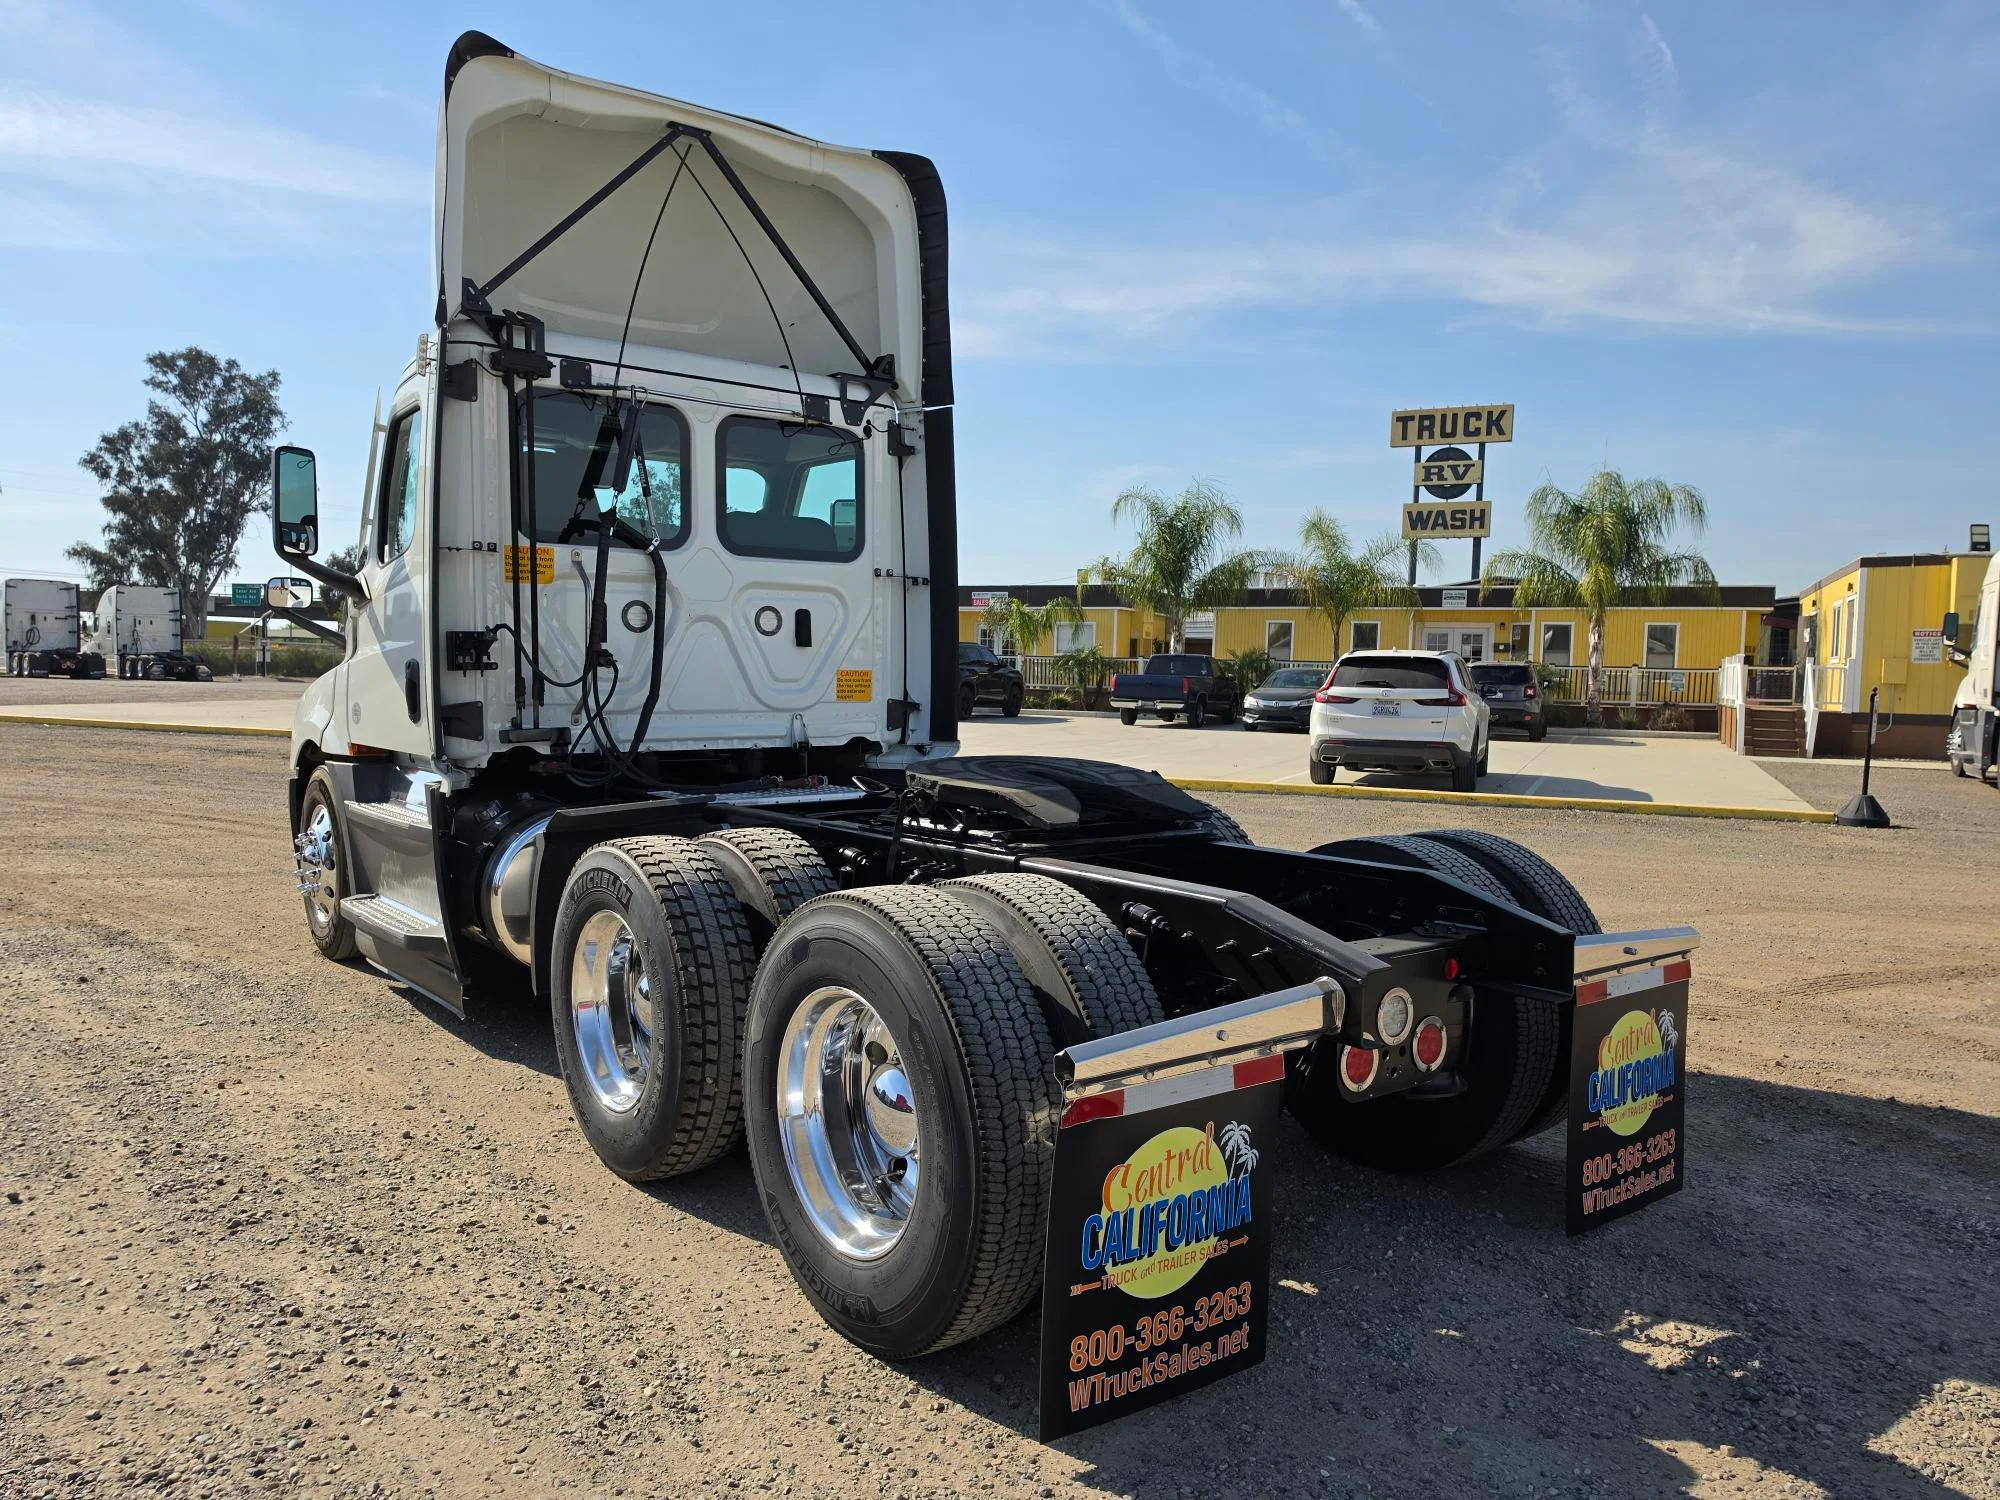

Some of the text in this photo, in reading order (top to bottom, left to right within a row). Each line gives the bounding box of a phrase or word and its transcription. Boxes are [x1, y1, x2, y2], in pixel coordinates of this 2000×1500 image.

[1395, 409, 1508, 441] TRUCK
[1421, 463, 1476, 482] RV
[1407, 508, 1486, 531] WASH
[573, 870, 632, 905] MICHELIN
[1599, 1007, 1656, 1071] Central
[1588, 1050, 1675, 1113] CALIFORNIA
[1599, 1114, 1618, 1128] TRUCK
[1627, 1105, 1648, 1120] TRAILER
[1648, 1096, 1664, 1111] SALES
[1102, 1120, 1215, 1214] Central
[1582, 1128, 1676, 1187] 800-366-3263
[1582, 1158, 1675, 1215] WTruckSales.net
[1081, 1173, 1251, 1271] CALIFORNIA
[1101, 1240, 1229, 1290] TRUCK and TRAILER SALES
[1069, 1280, 1252, 1373] 800-366-3263
[1068, 1321, 1250, 1413] WTruckSales.net
